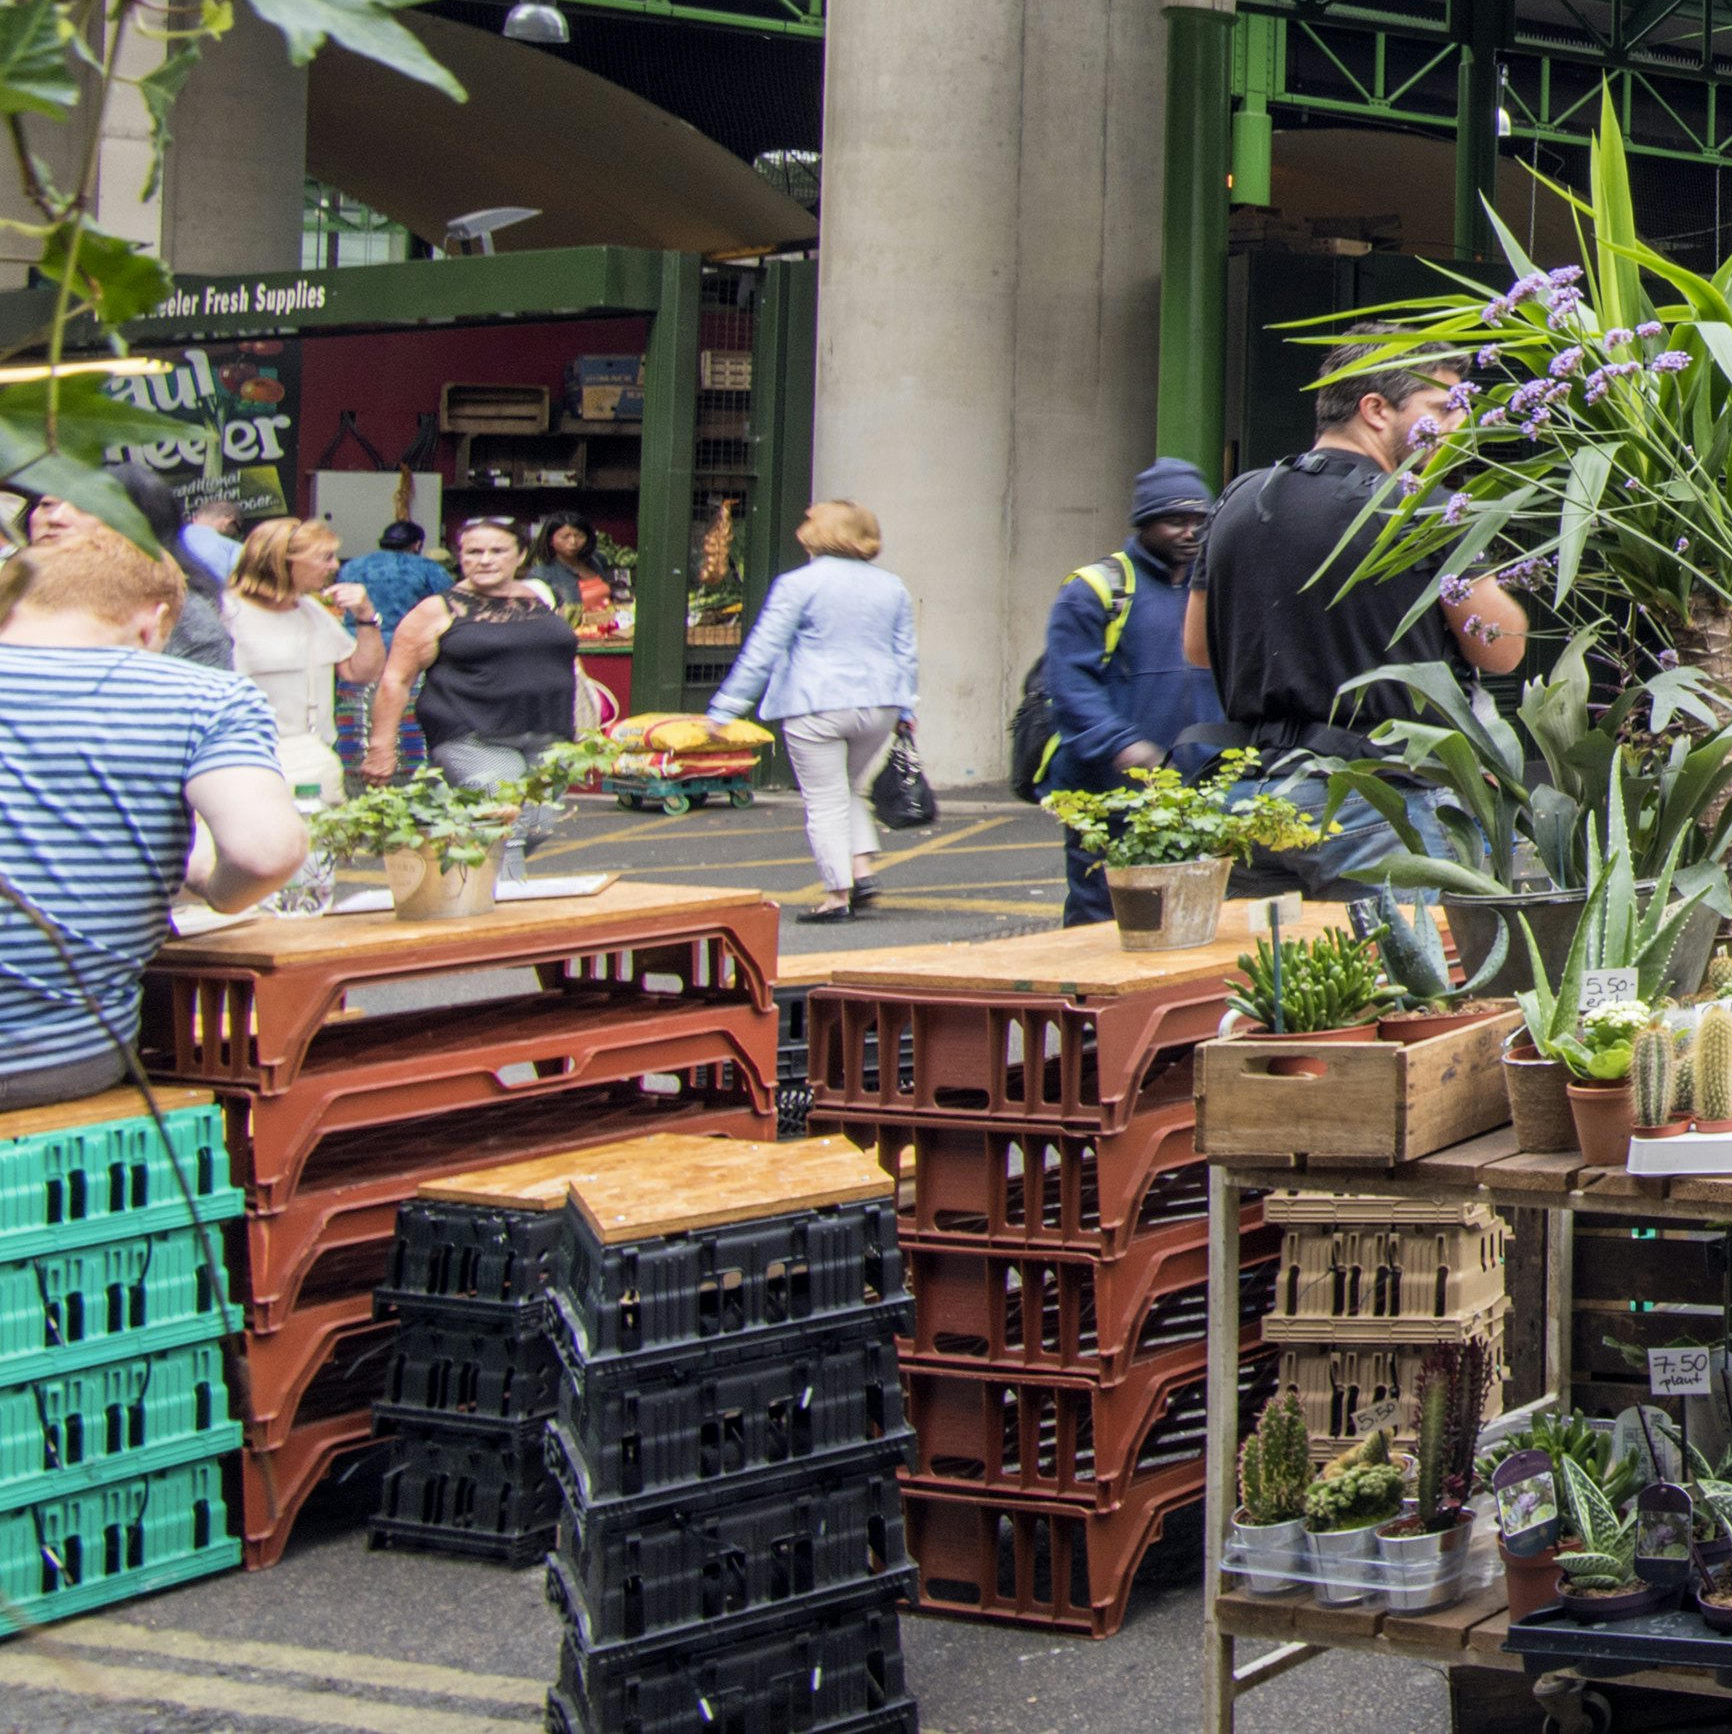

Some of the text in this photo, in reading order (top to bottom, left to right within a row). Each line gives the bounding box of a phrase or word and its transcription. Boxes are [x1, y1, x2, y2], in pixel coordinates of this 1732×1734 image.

[203, 284, 249, 316] Fresh
[254, 279, 326, 316] Supplies
[1652, 1354, 1709, 1375] 7.50
[1658, 1374, 1704, 1393] plant
[1356, 1402, 1397, 1433] 5.50
